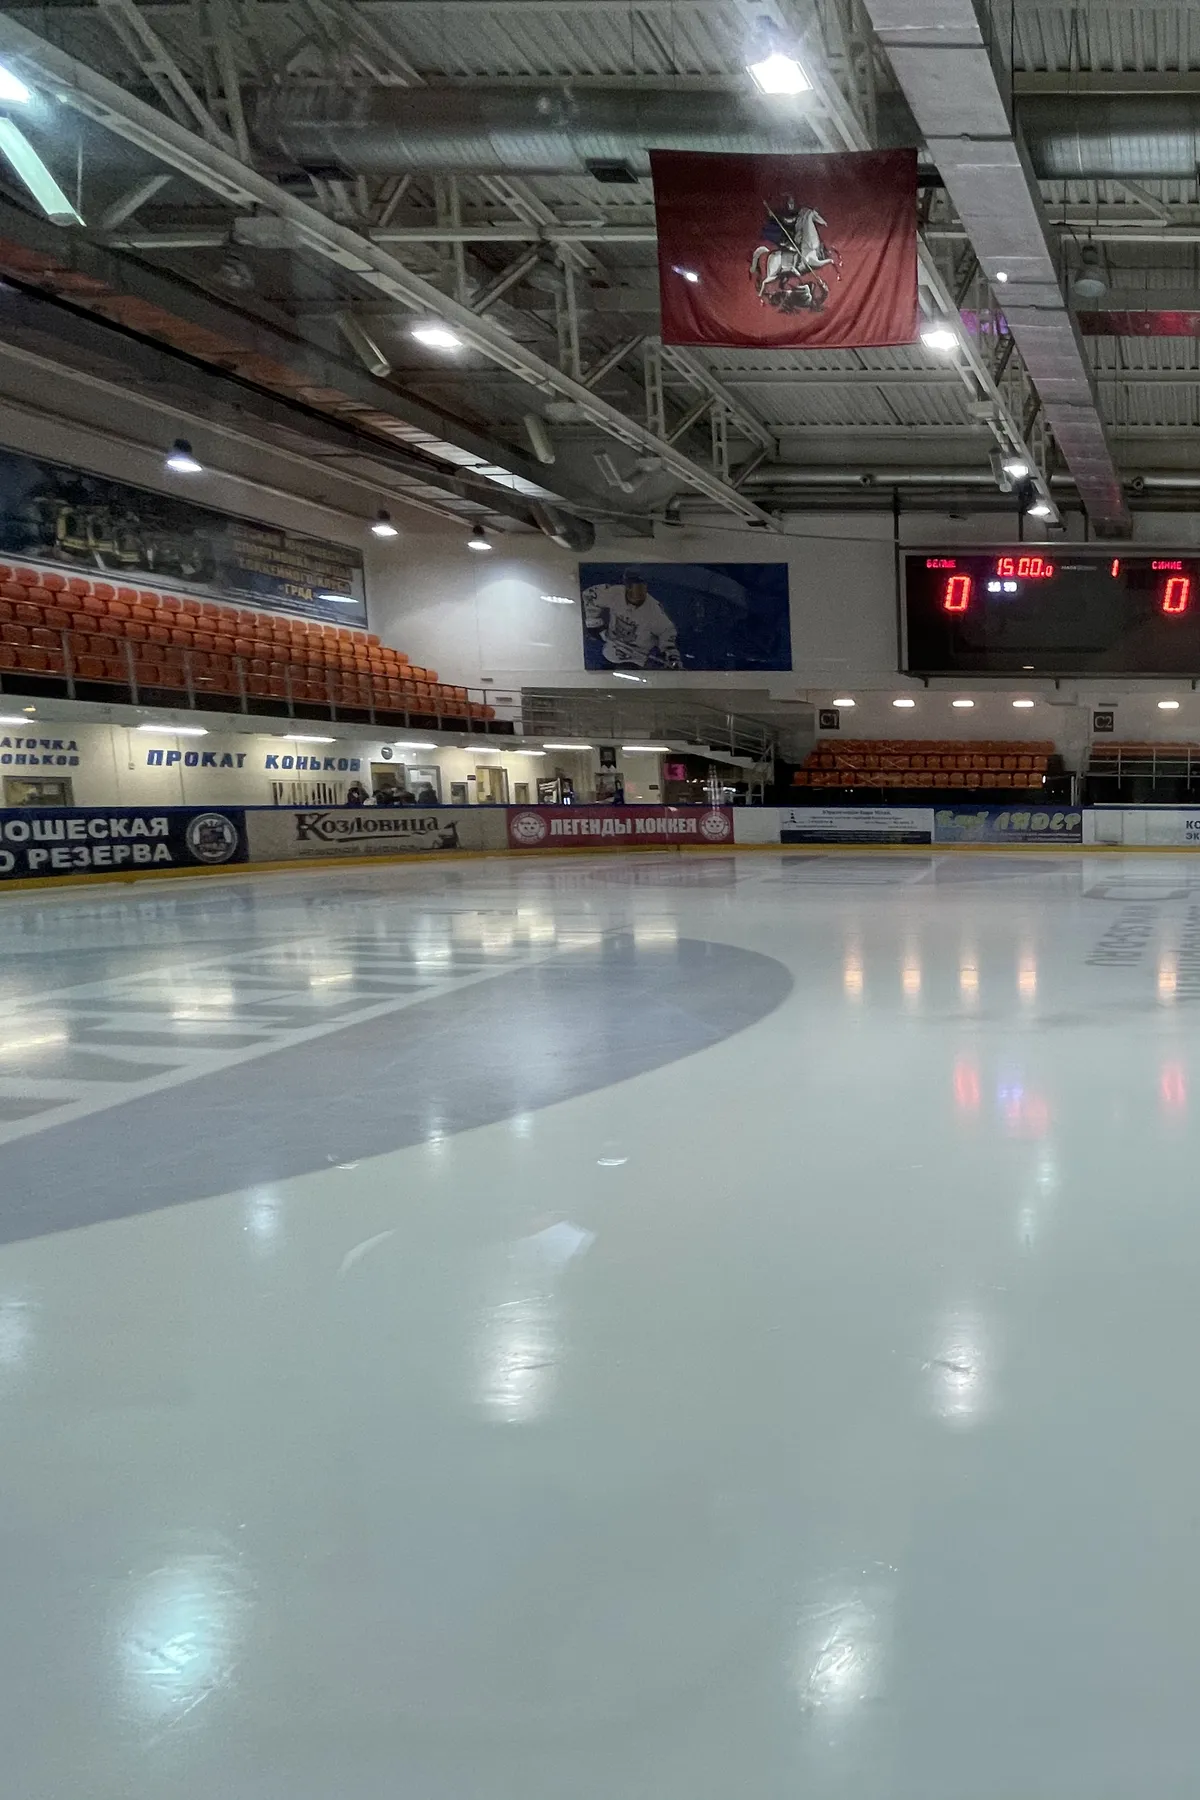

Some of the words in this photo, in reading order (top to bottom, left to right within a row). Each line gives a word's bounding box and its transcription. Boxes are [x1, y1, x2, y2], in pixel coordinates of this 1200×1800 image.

[1111, 558, 1120, 577] 1
[1151, 560, 1182, 570] СИНИЕ
[944, 575, 971, 611] 0
[1162, 577, 1190, 612] 0
[1094, 715, 1112, 728] C2
[146, 749, 247, 769] ПРОКАТ
[265, 754, 362, 772] КОНЬКОВ
[0, 817, 170, 842] ОШЕСКАЯ
[550, 818, 632, 838] ЛЕГЕНДЫ
[634, 817, 698, 834] ХОККЕЯ
[28, 844, 173, 870] РЕЗЕРВА
